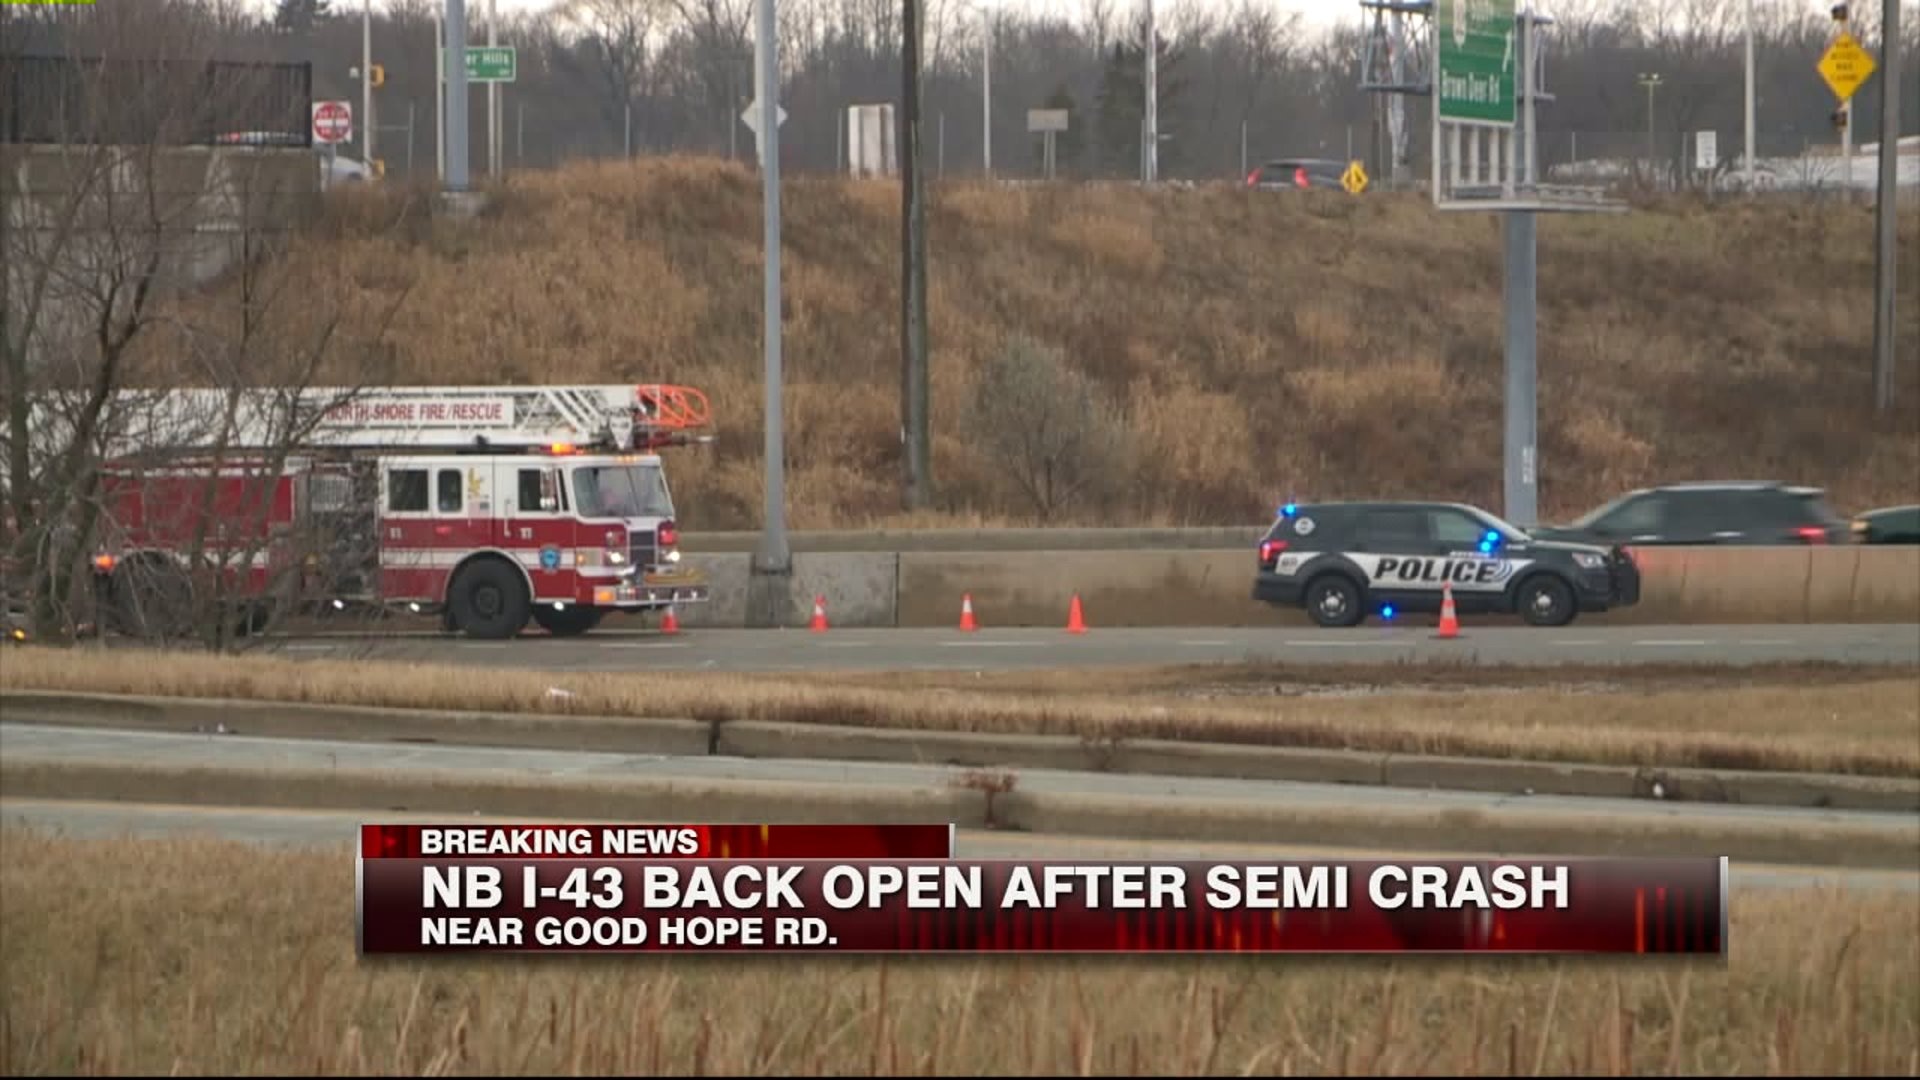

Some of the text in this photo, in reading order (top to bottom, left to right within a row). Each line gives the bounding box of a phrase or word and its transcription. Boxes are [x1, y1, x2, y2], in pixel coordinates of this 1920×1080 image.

[1441, 68, 1467, 101] Brown
[1468, 71, 1488, 104] Deer
[419, 402, 503, 420] FIRE/RESCUE
[1373, 557, 1496, 582] POLICE
